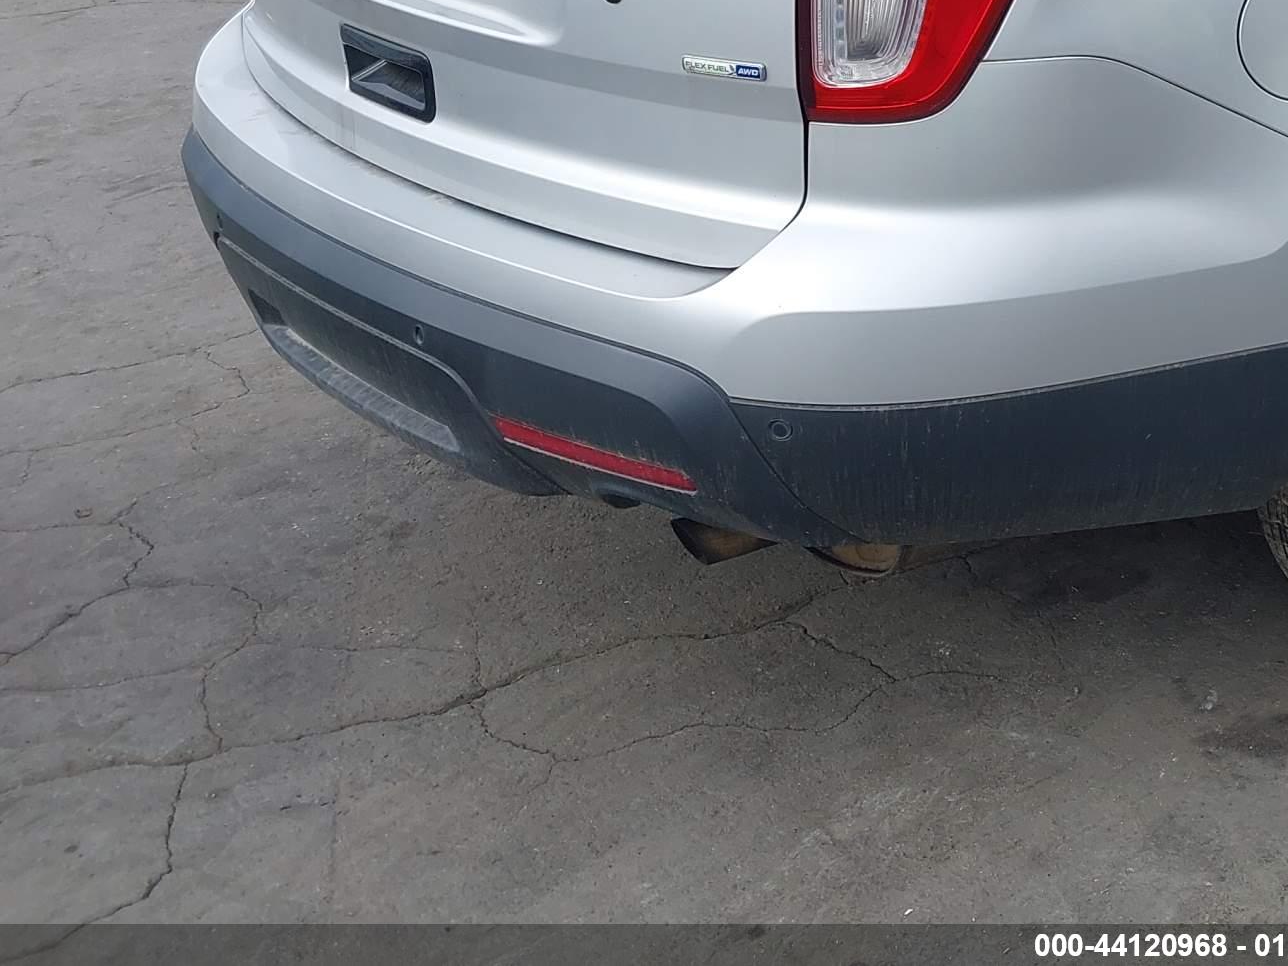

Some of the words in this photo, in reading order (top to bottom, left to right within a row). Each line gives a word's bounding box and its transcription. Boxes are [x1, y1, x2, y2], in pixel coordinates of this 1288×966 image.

[685, 60, 706, 70] FLEX
[708, 64, 730, 74] FUEL
[737, 67, 759, 77] AWD
